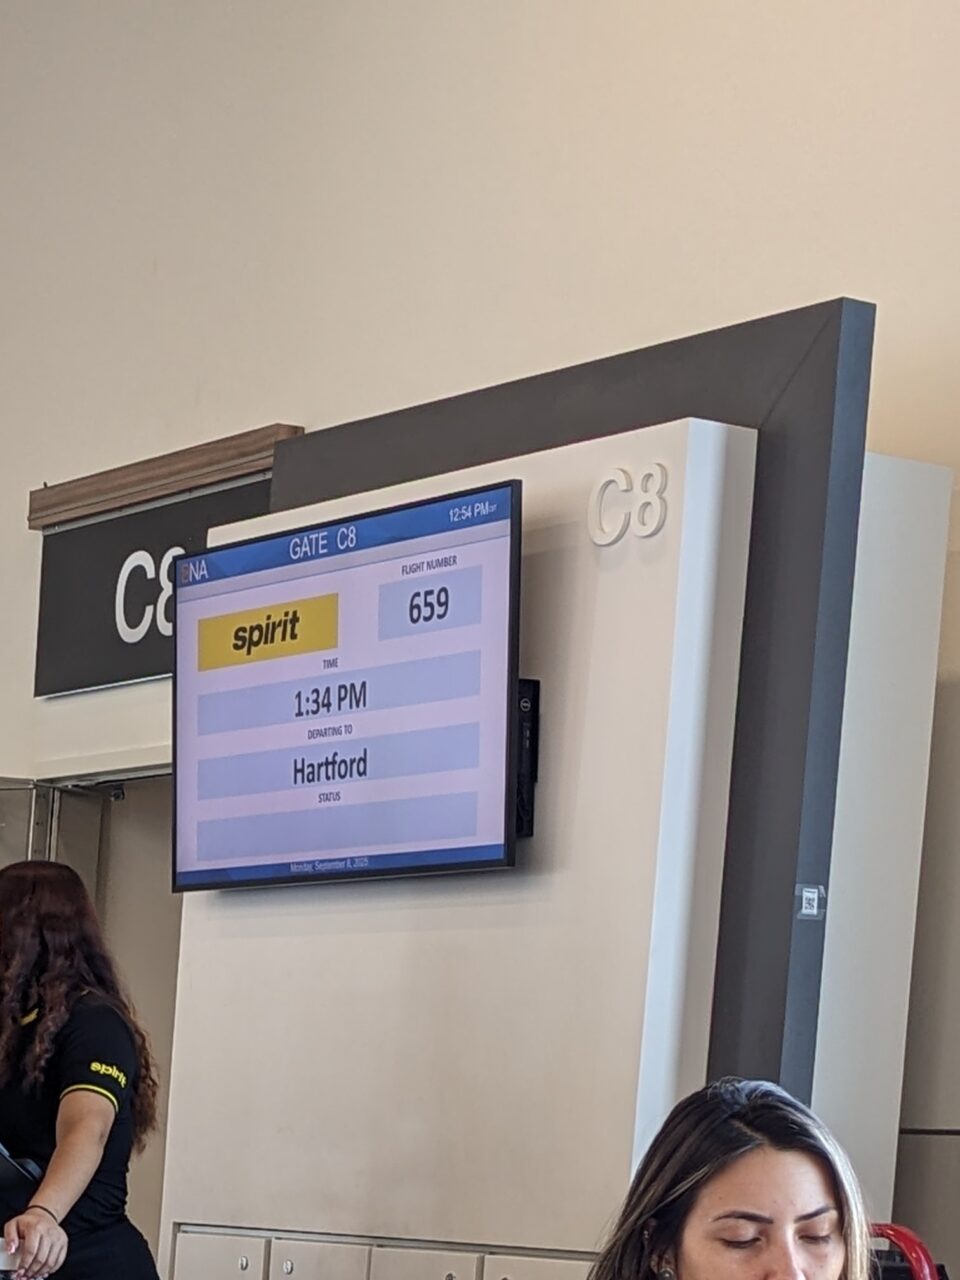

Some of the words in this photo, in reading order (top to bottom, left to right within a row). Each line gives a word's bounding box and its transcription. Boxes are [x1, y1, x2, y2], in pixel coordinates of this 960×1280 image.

[449, 504, 472, 522] 12:54
[474, 501, 489, 517] PM
[587, 462, 668, 547] C8
[290, 531, 328, 559] GATE
[337, 526, 356, 550] C8
[401, 562, 425, 576] FLIGHT
[426, 555, 458, 571] NUMBER
[409, 586, 449, 624] 659
[232, 610, 300, 656] spirit
[323, 657, 339, 669] TIME
[294, 685, 333, 718] 1:34
[337, 680, 367, 711] PM
[307, 725, 343, 740] DEPARTING
[344, 723, 353, 735] TO
[293, 748, 368, 785] Hartford
[318, 791, 341, 804] STATUS
[90, 1061, 126, 1088] spirit
